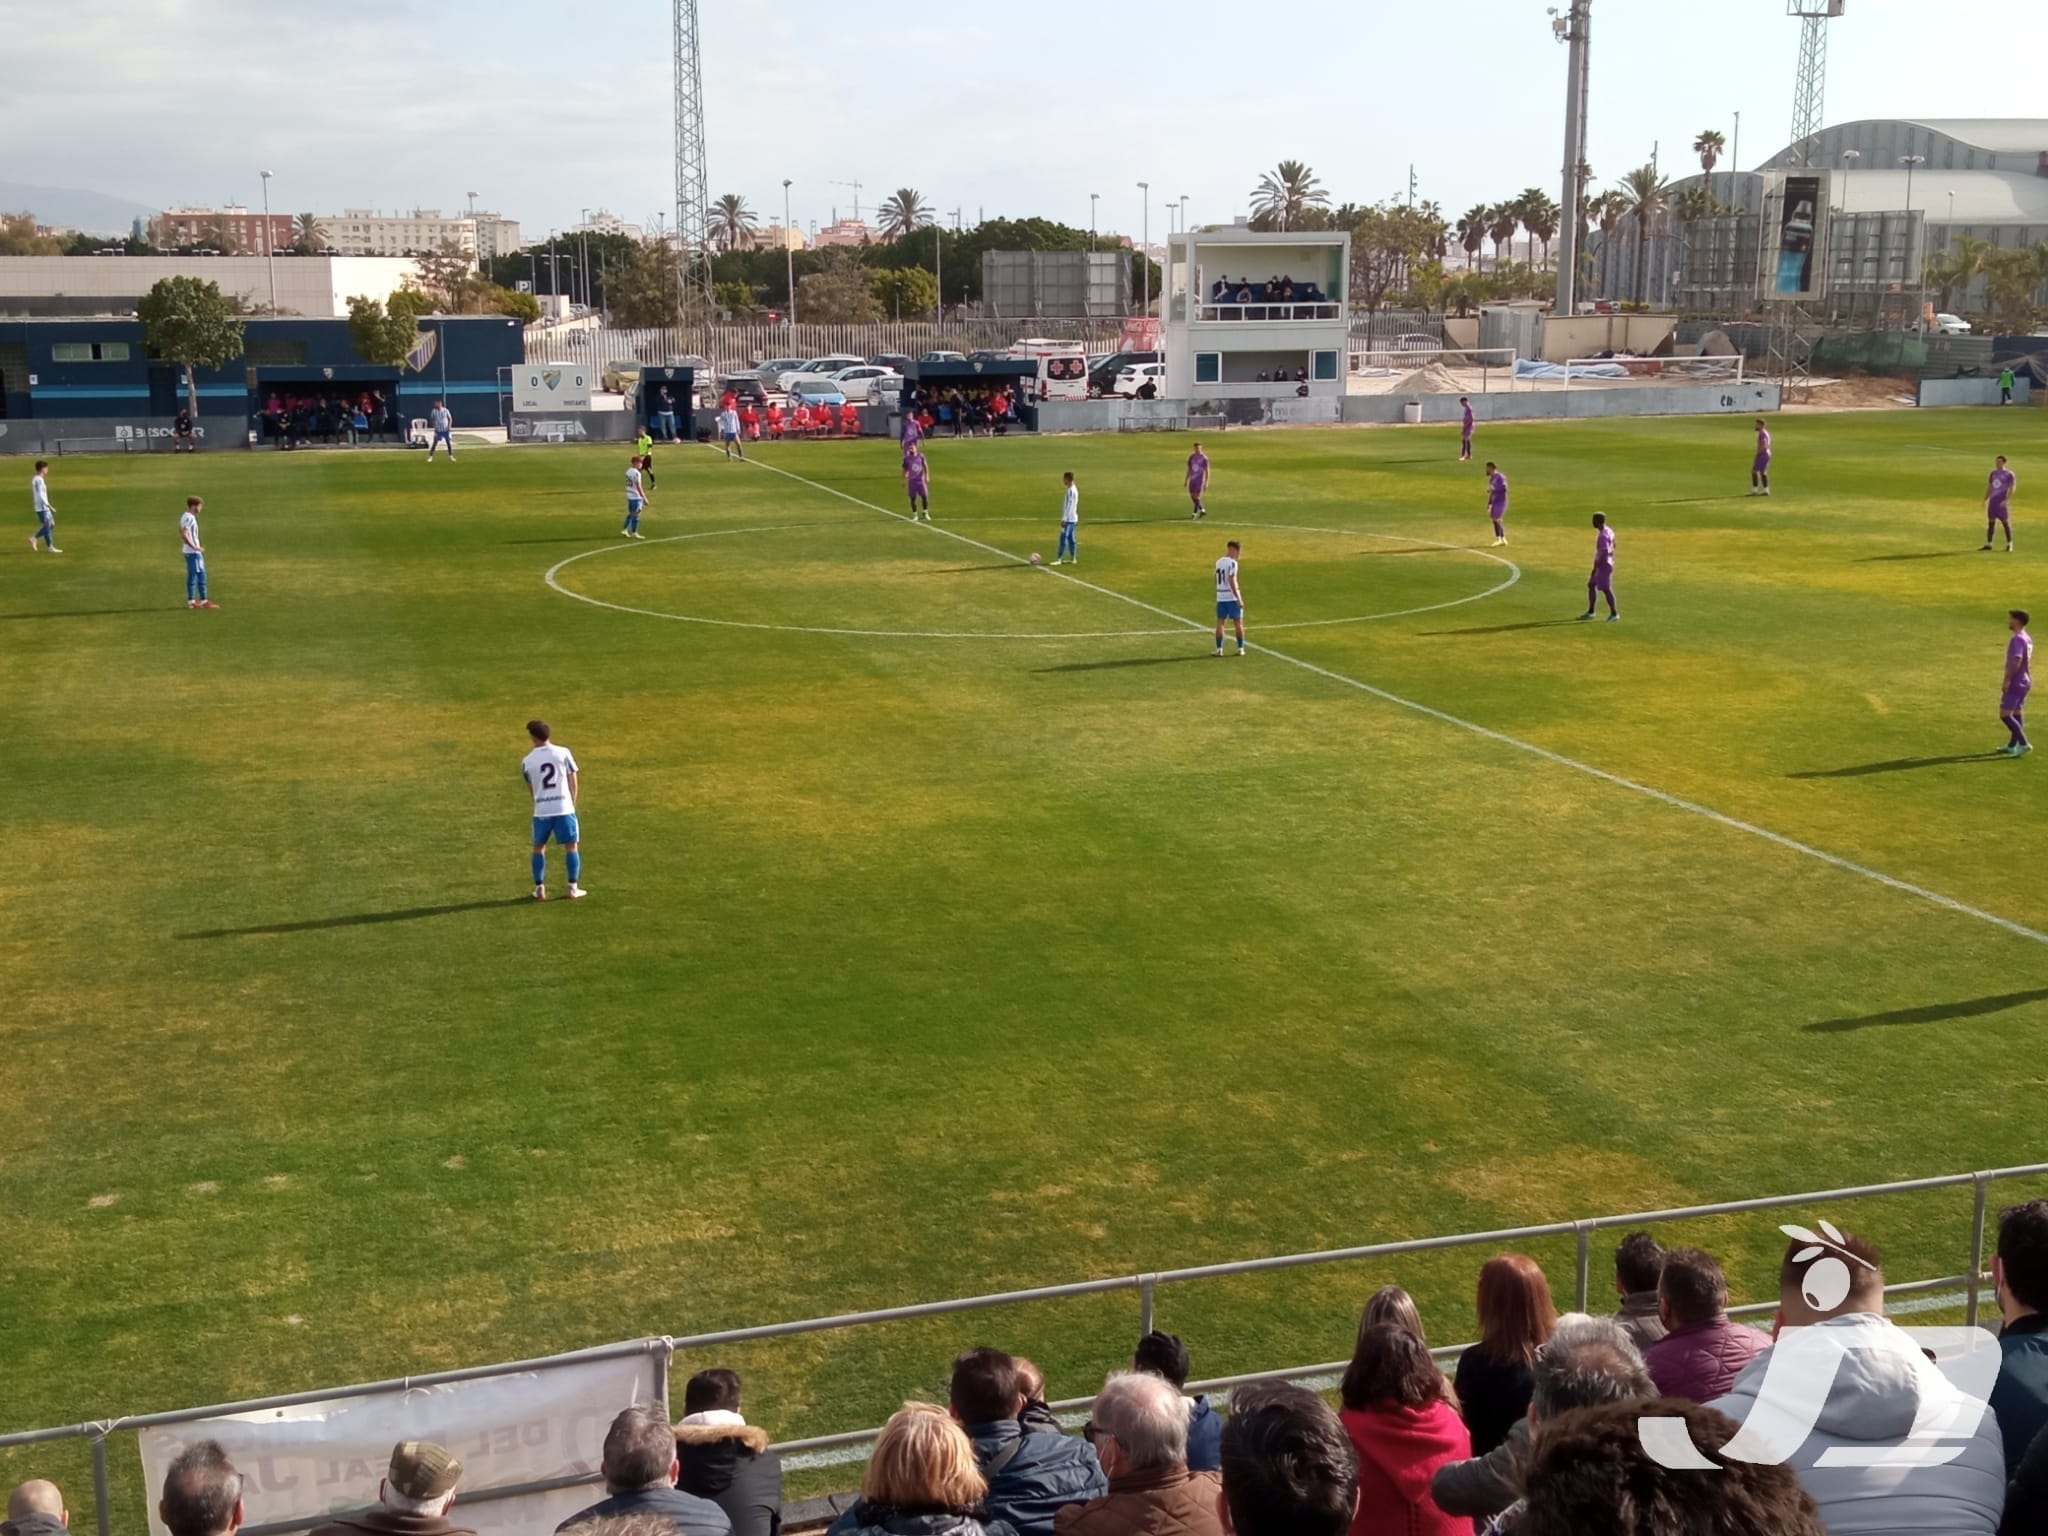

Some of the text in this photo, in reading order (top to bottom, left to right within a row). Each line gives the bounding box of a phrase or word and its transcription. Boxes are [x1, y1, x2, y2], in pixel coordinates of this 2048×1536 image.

[531, 375, 583, 388] 0 0
[1216, 568, 1226, 585] 11
[540, 762, 557, 790] 2
